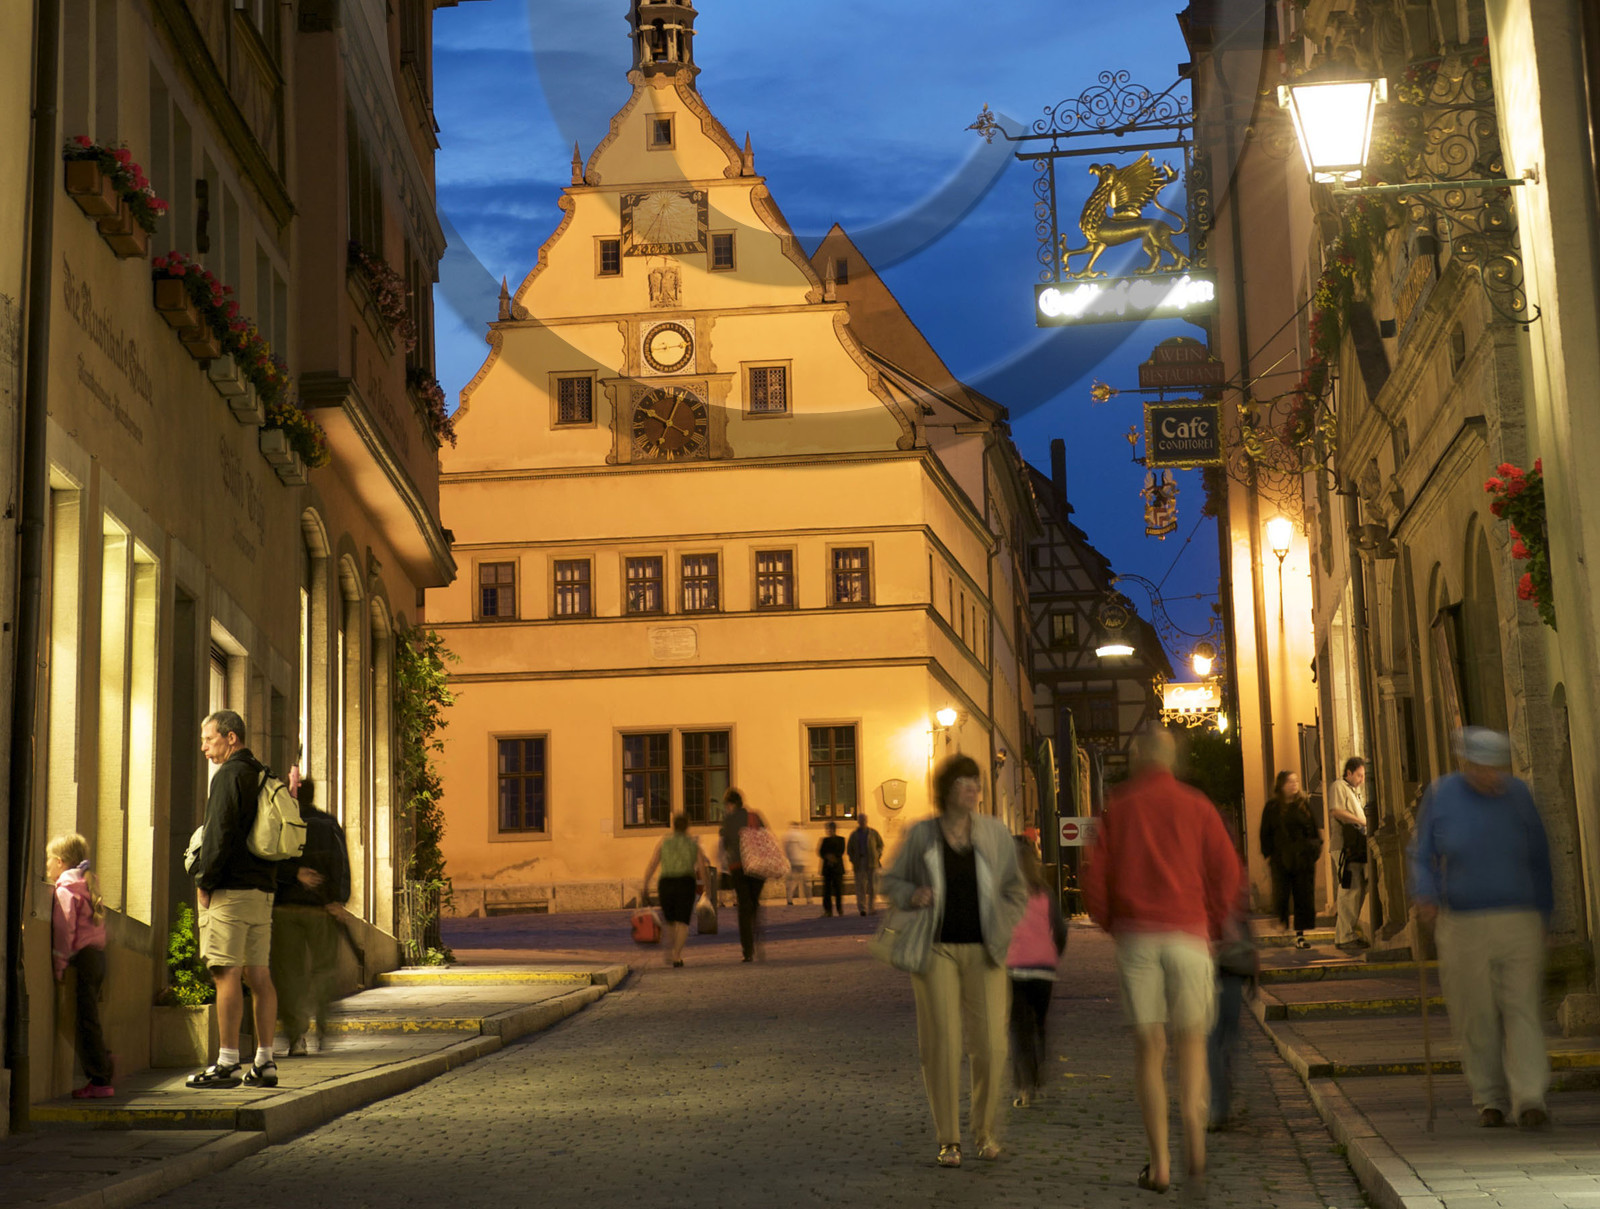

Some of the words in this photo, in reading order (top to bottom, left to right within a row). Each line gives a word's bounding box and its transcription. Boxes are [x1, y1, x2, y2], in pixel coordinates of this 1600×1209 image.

[1159, 347, 1203, 361] WEIN
[1141, 367, 1223, 383] RESTAURANT
[1161, 416, 1210, 439] Cafe
[1158, 438, 1213, 451] CONDITOREI
